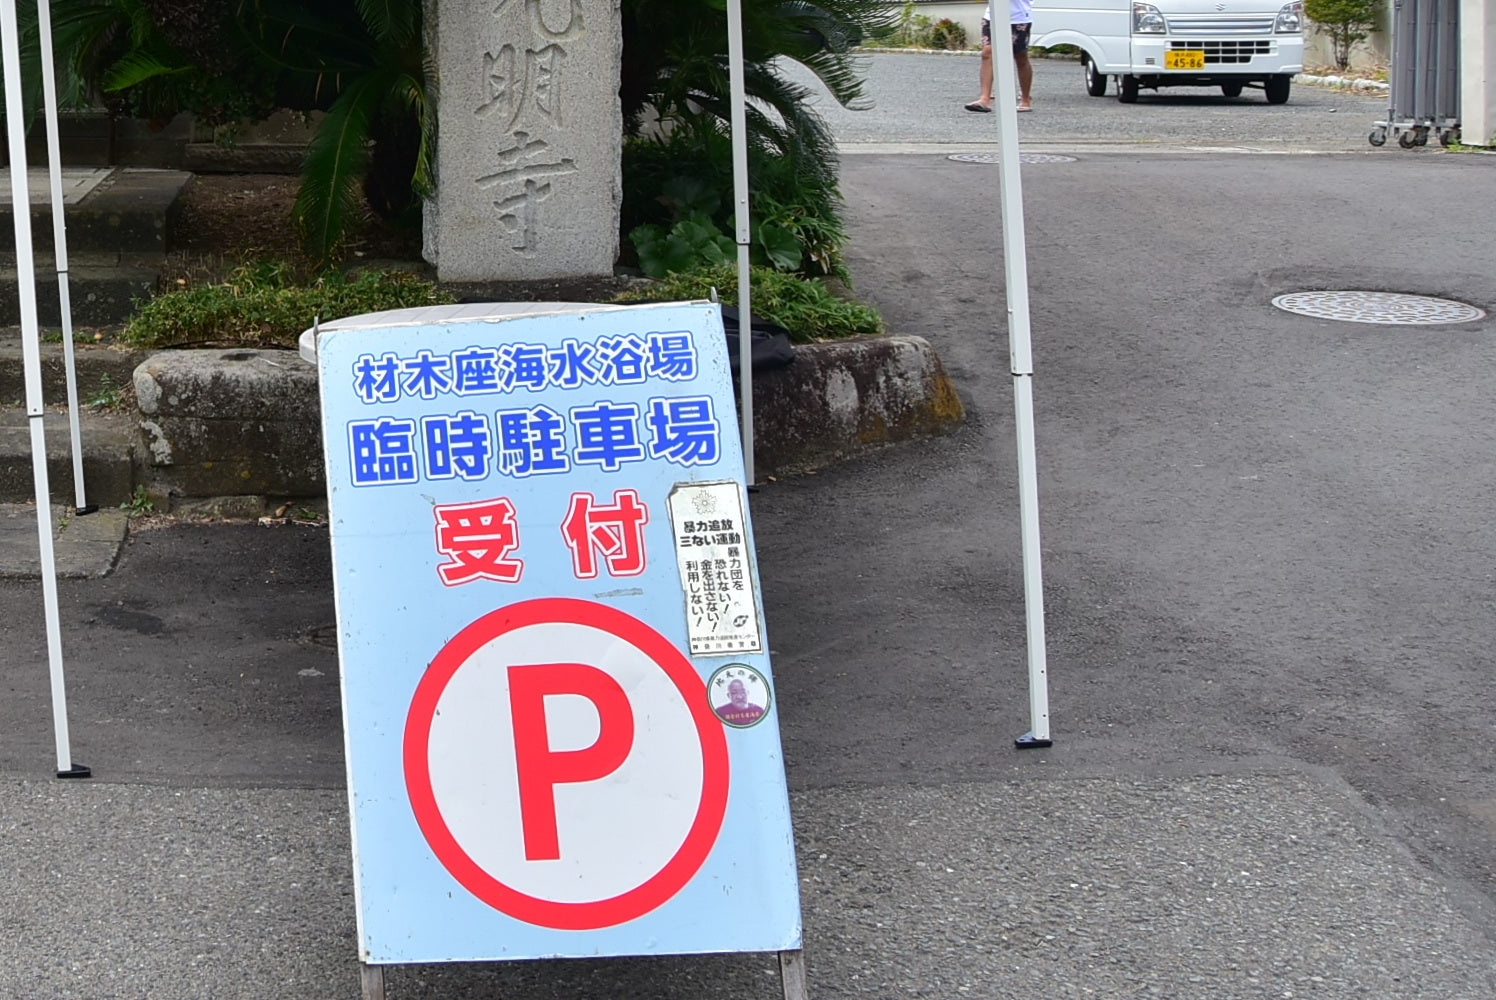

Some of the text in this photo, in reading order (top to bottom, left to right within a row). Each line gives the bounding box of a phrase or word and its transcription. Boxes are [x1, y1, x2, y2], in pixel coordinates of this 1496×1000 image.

[353, 331, 697, 404] 材木座海水浴場
[348, 396, 721, 487] 臨時駐車場
[679, 532, 741, 548] 三ない運動
[683, 518, 734, 534] 暴力追放
[727, 546, 745, 591] 暴力団を
[506, 662, 635, 862] P
